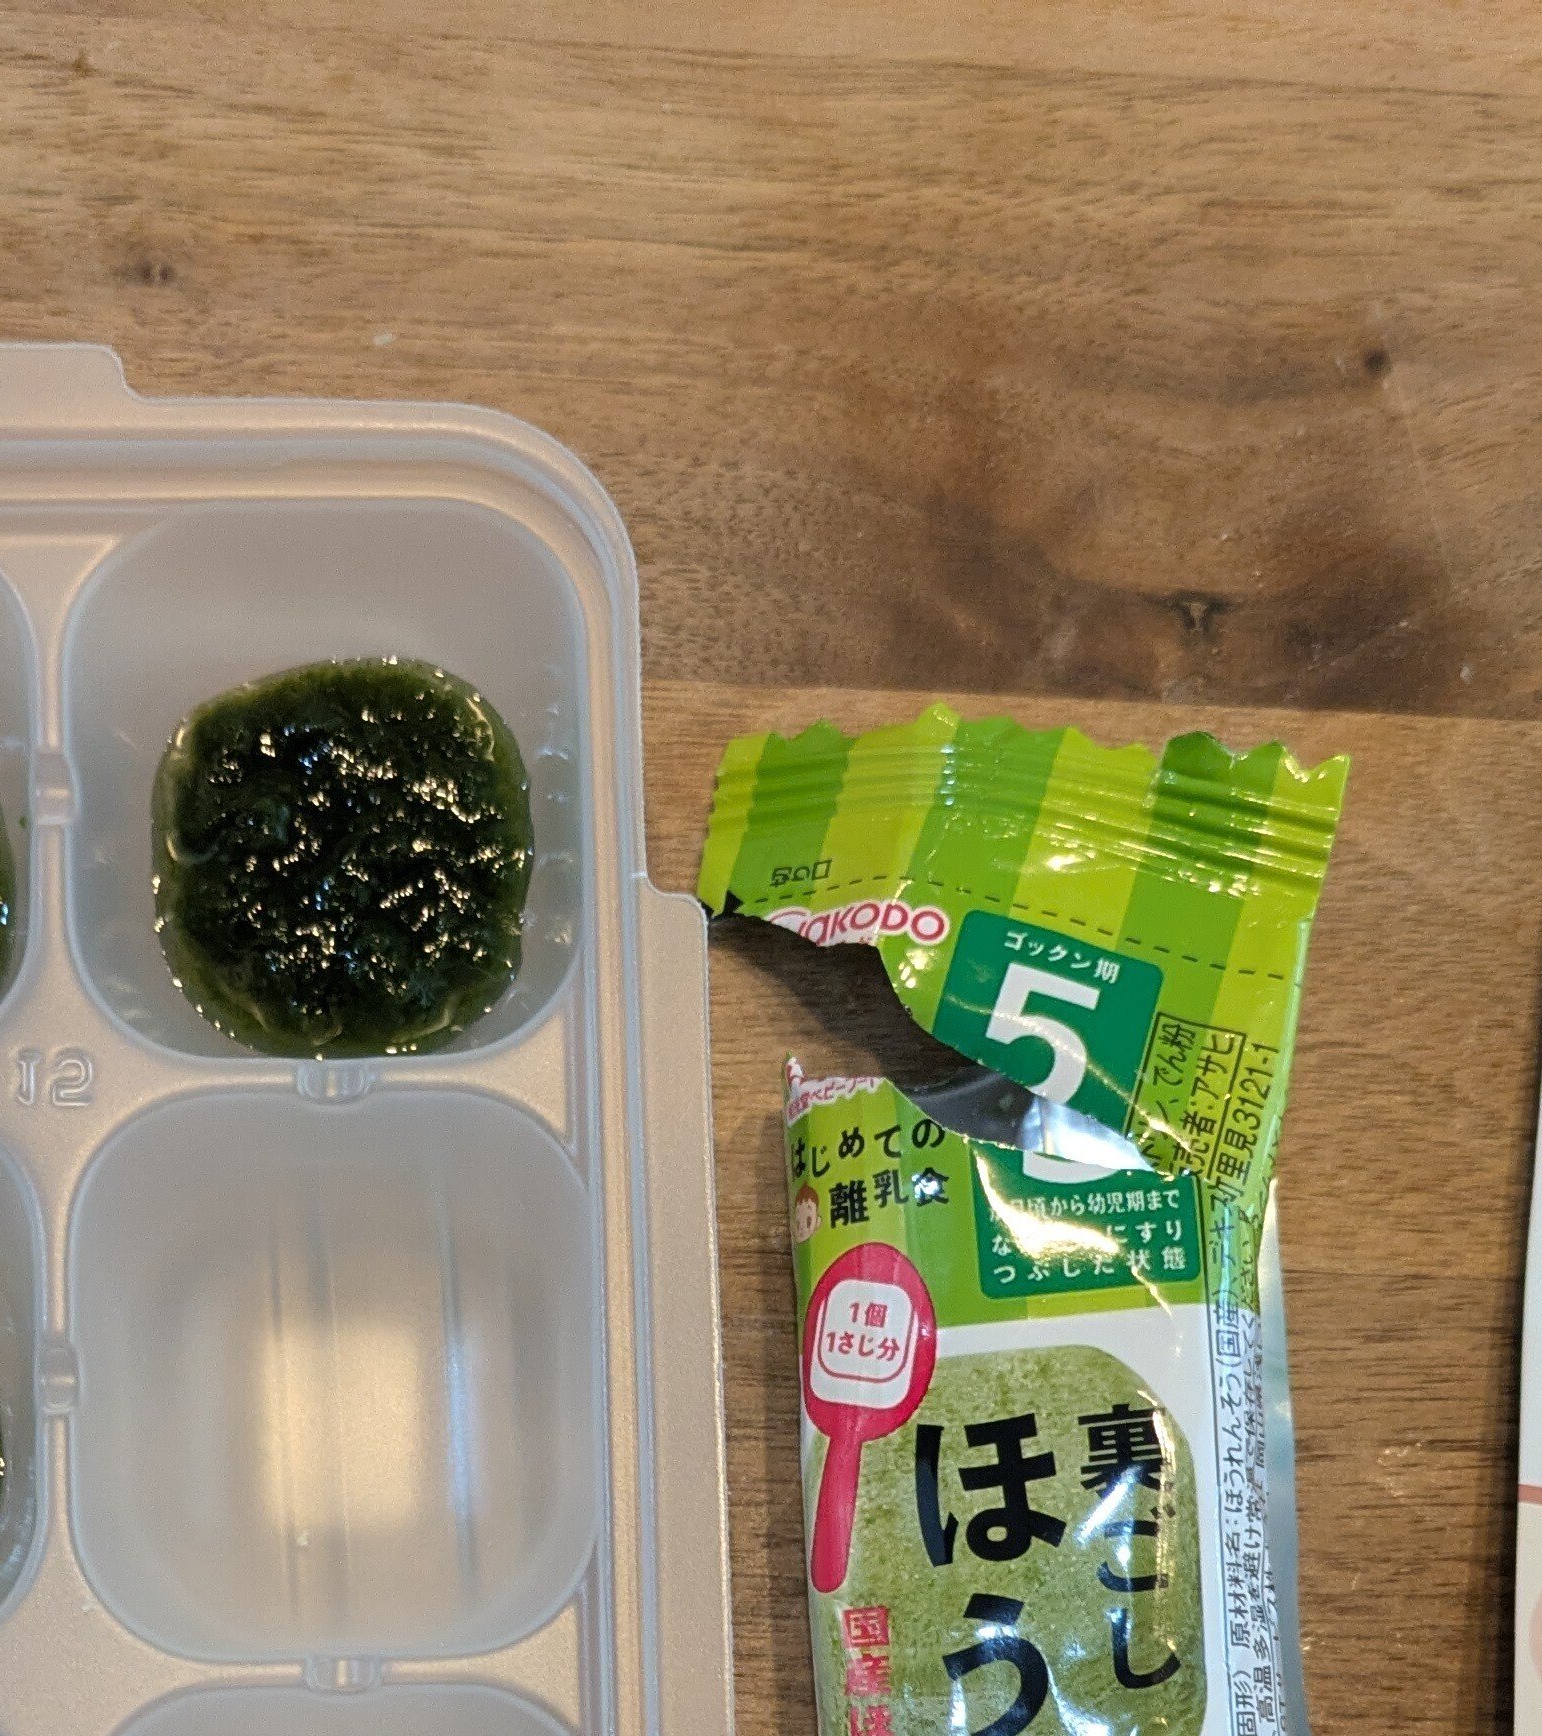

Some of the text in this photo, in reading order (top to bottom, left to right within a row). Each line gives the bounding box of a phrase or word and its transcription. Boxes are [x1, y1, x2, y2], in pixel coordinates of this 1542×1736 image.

[1004, 930, 1120, 985] ゴックン期
[790, 1117, 947, 1179] はじめての
[827, 1166, 950, 1229] 離乳食
[849, 1301, 888, 1328] 1個
[826, 1330, 900, 1362] 1さじ分
[1077, 1402, 1182, 1690] 裏ごし
